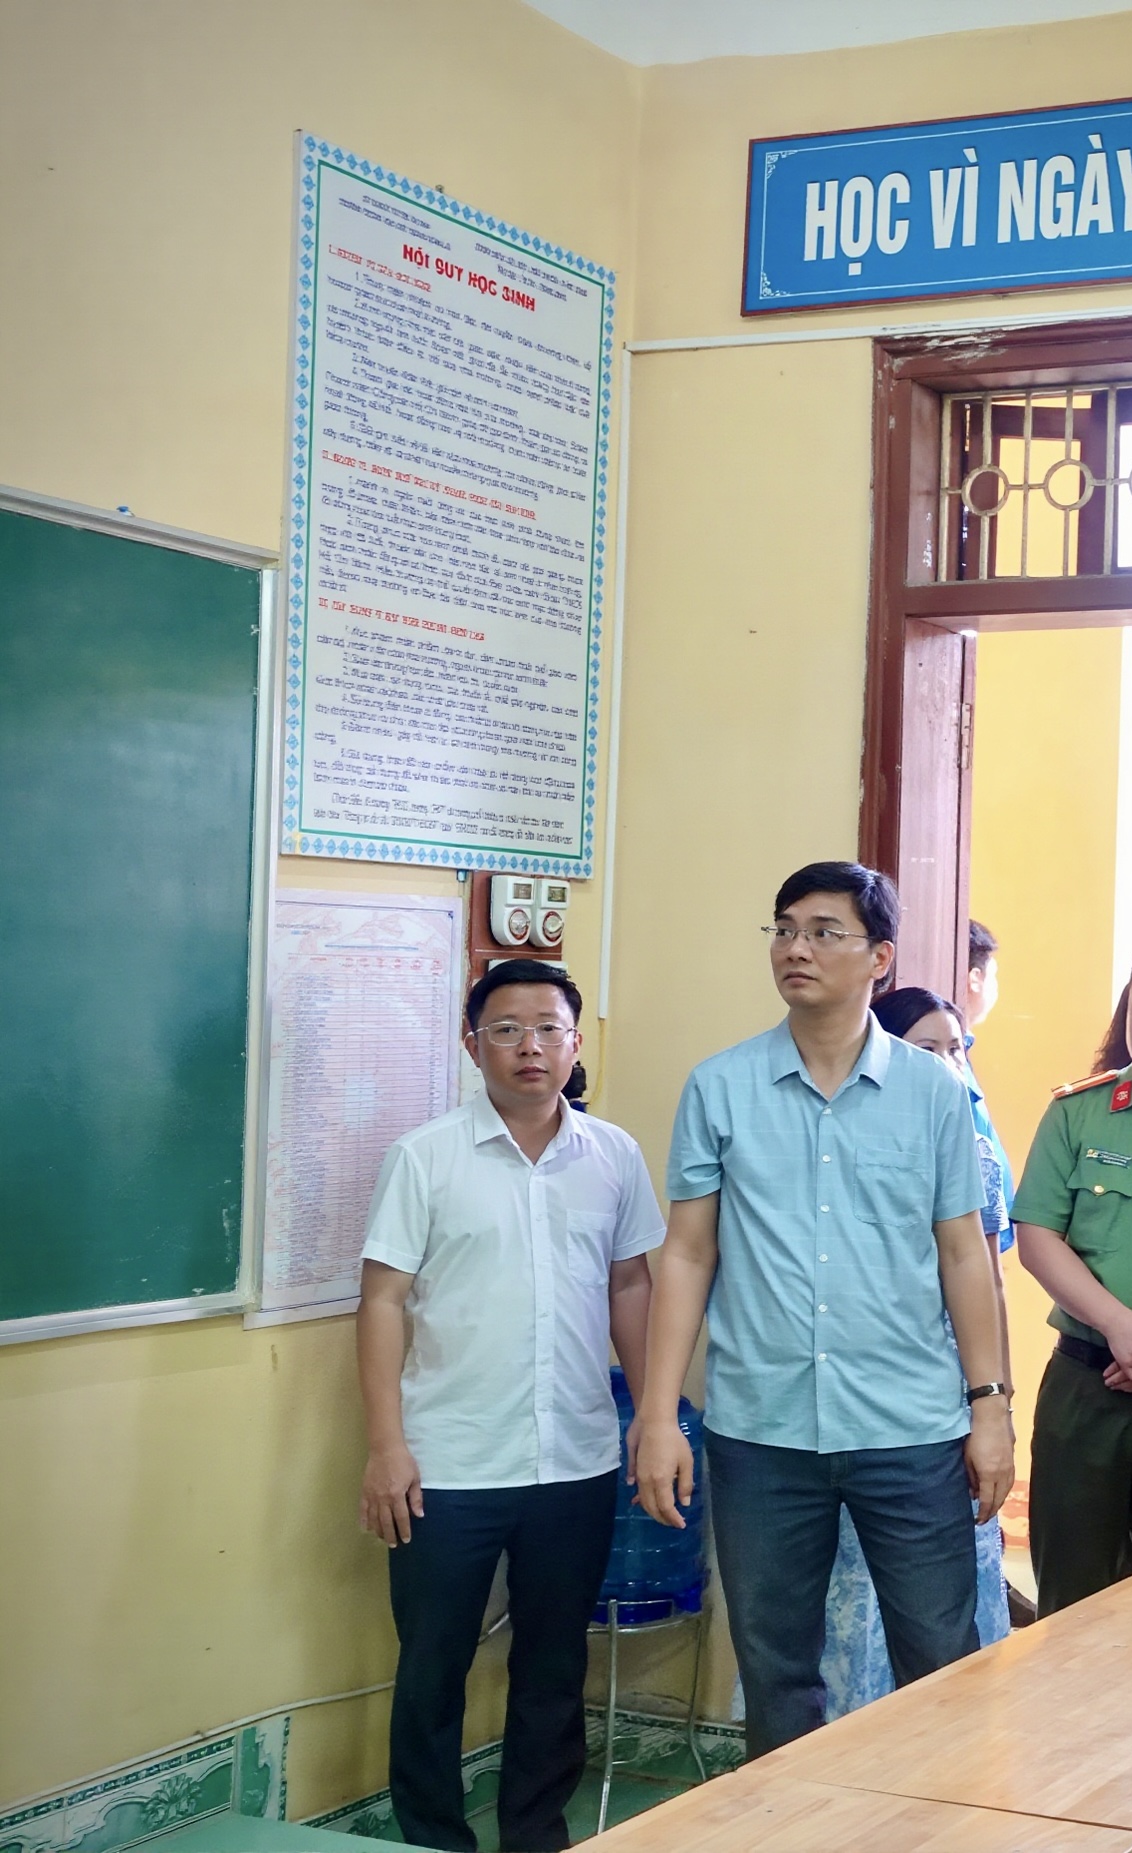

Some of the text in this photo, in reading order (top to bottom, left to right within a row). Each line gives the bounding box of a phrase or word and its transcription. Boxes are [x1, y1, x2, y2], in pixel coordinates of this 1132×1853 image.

[804, 173, 910, 276] HỌC
[929, 148, 979, 249] VÌ
[468, 271, 497, 296] HỌC
